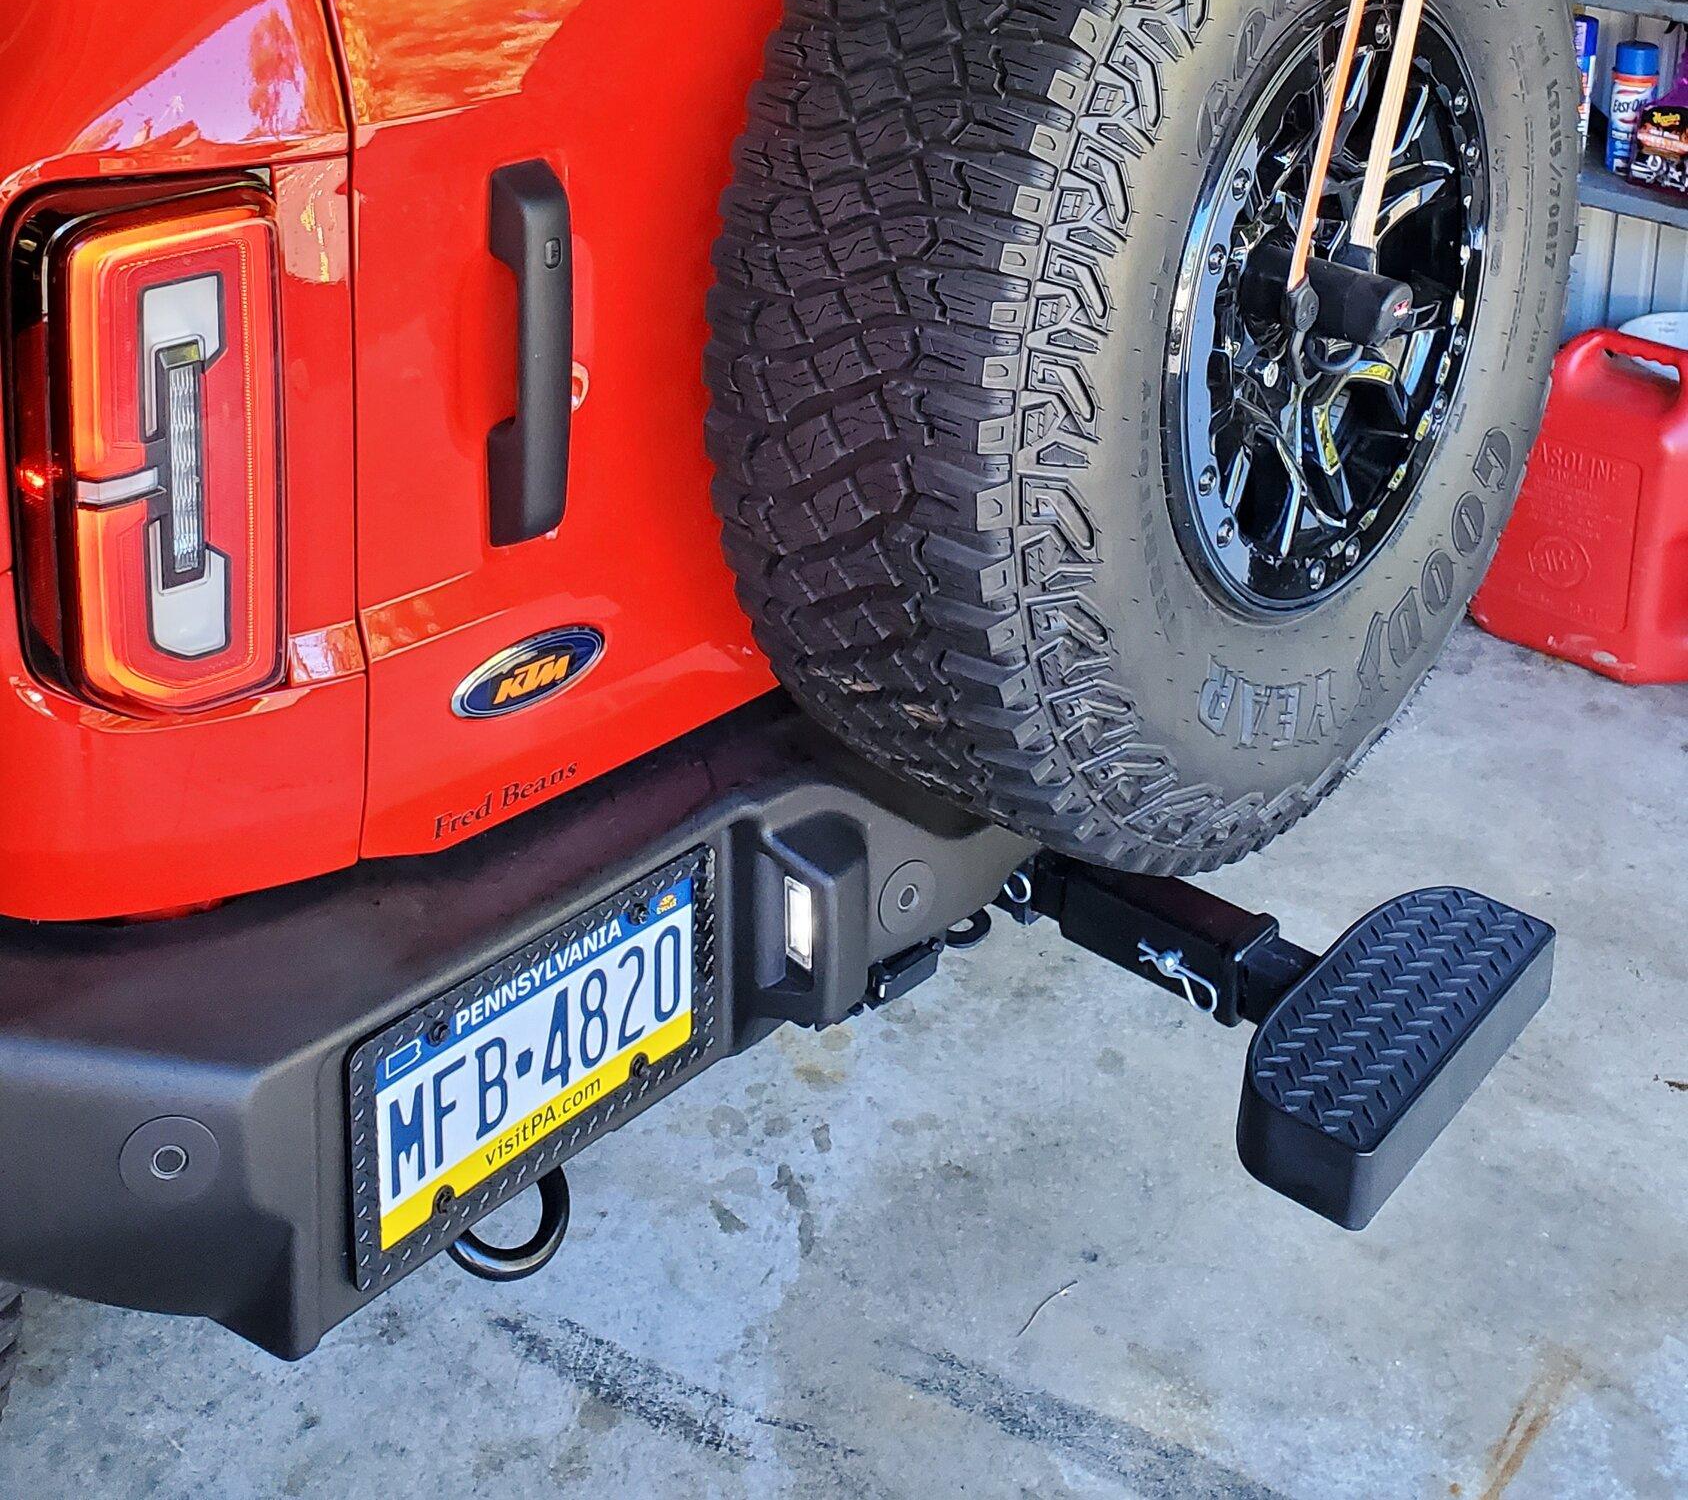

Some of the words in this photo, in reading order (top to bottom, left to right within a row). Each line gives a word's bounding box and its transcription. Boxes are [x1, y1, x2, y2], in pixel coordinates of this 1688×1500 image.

[1613, 99, 1630, 113] EASY
[1536, 441, 1617, 484] ASOLINE
[493, 654, 571, 705] KTM
[432, 791, 493, 841] Fred
[501, 761, 579, 811] Beans
[455, 920, 623, 1036] PENNSYLVANIA
[484, 1077, 601, 1167] visitPA.com
